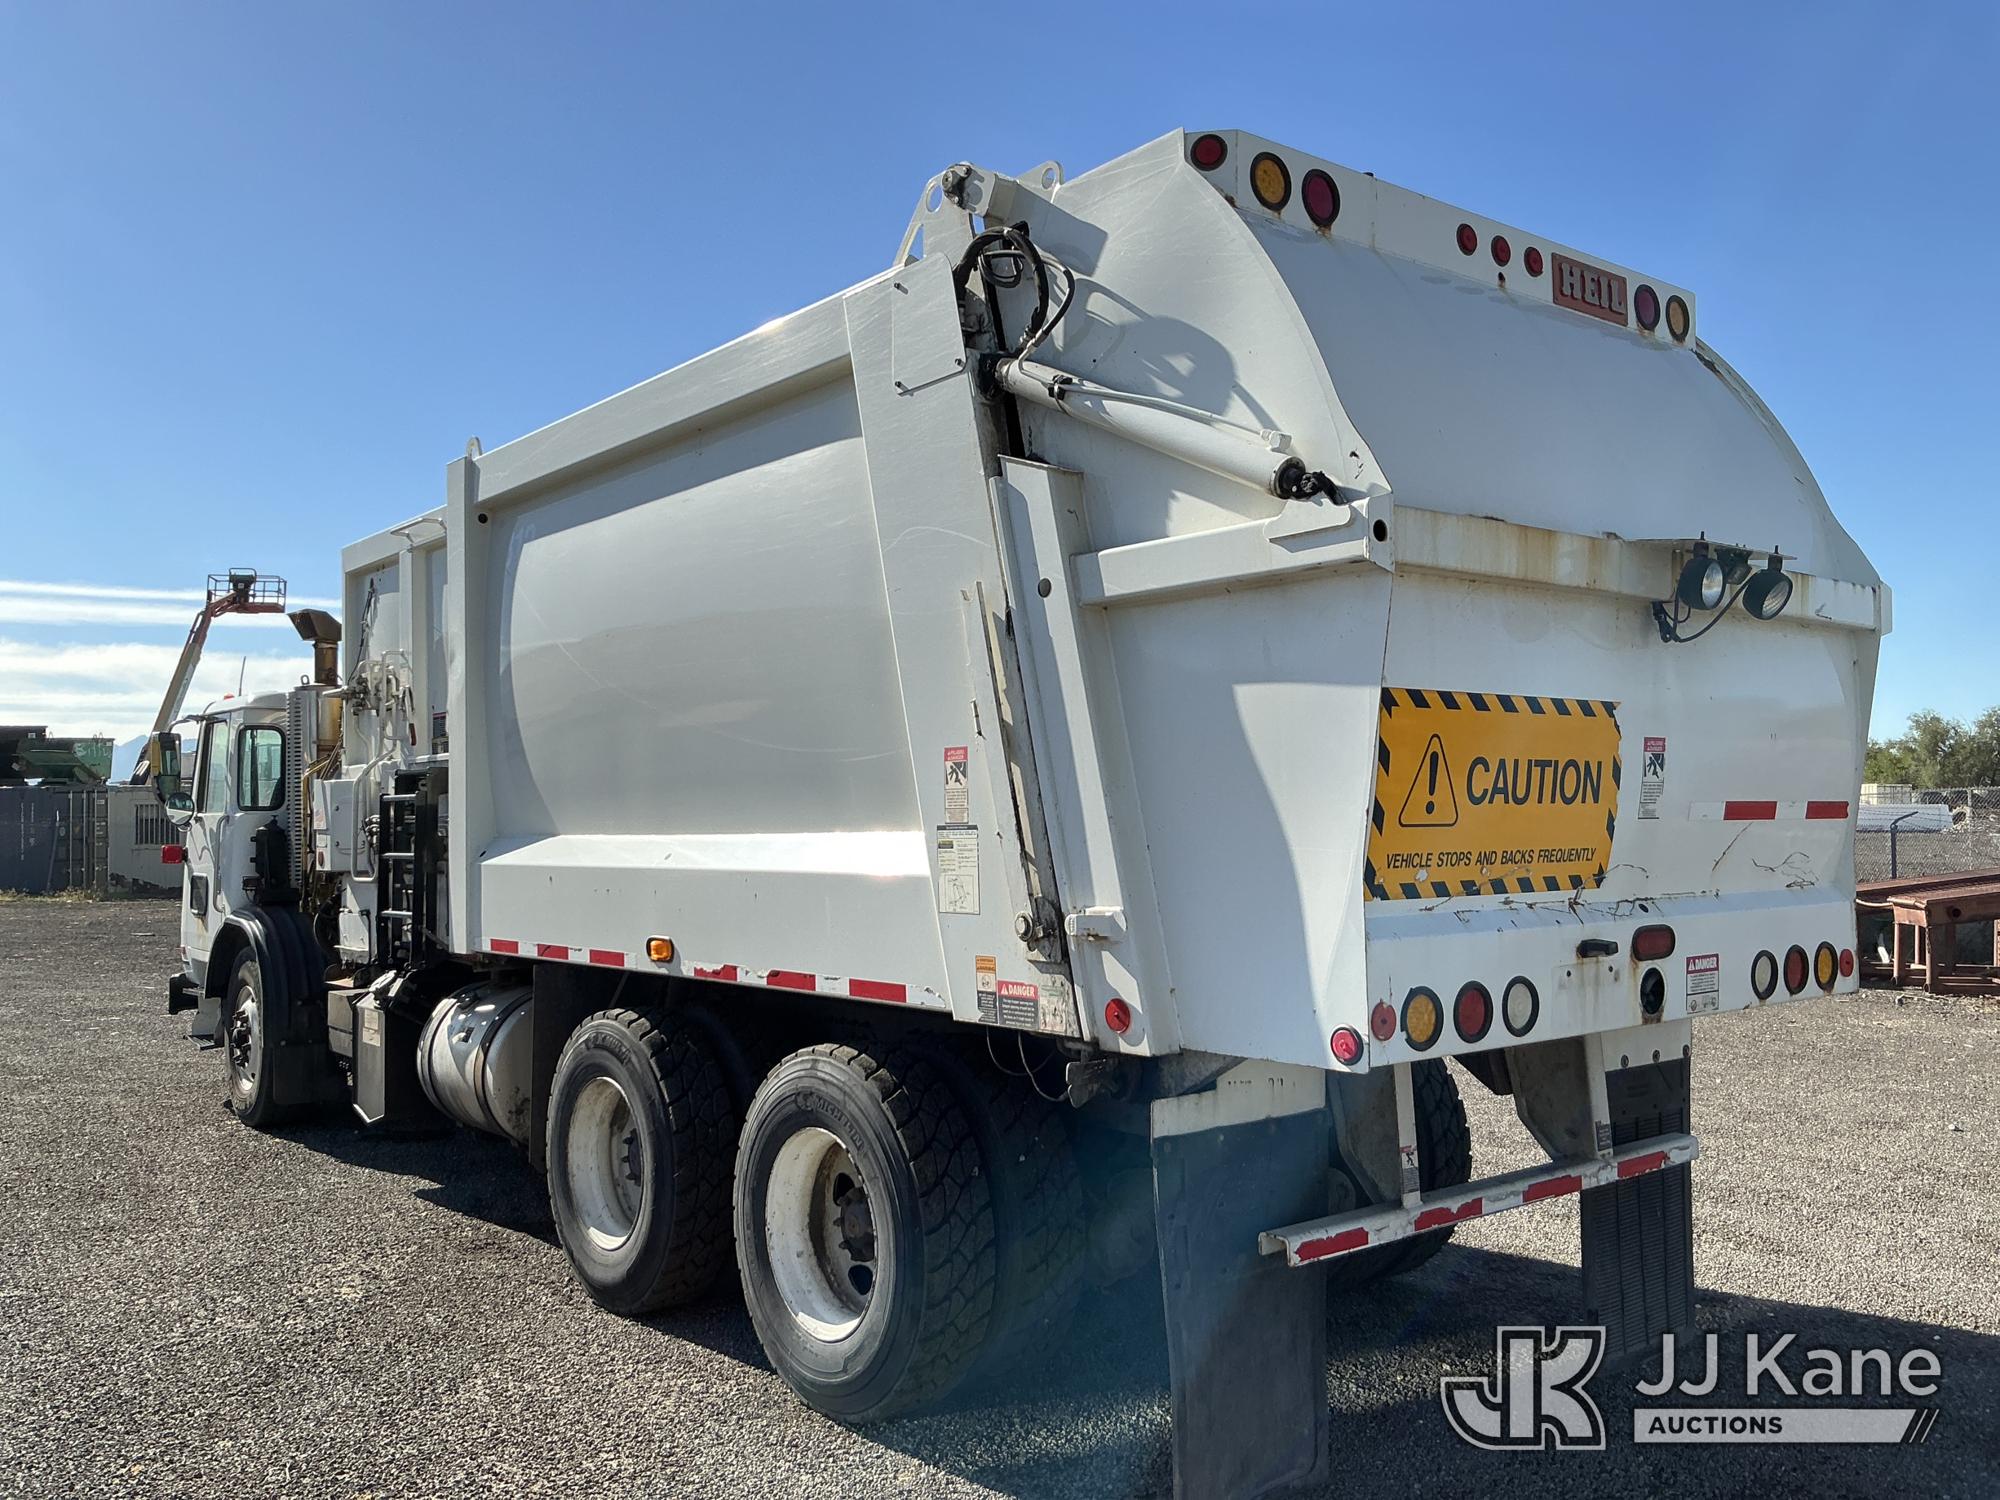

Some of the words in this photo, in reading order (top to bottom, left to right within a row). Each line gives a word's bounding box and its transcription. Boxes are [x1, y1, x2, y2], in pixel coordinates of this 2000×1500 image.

[1560, 262, 1626, 314] HEIL
[1466, 756, 1602, 806] CAUTION
[1386, 852, 1433, 869] VEHICLE
[1436, 851, 1472, 867] STOPS
[1475, 850, 1498, 865] AND
[1500, 849, 1535, 865] BACKS
[1537, 847, 1597, 864] FREQUENTLY
[1008, 984, 1036, 998] DANGER
